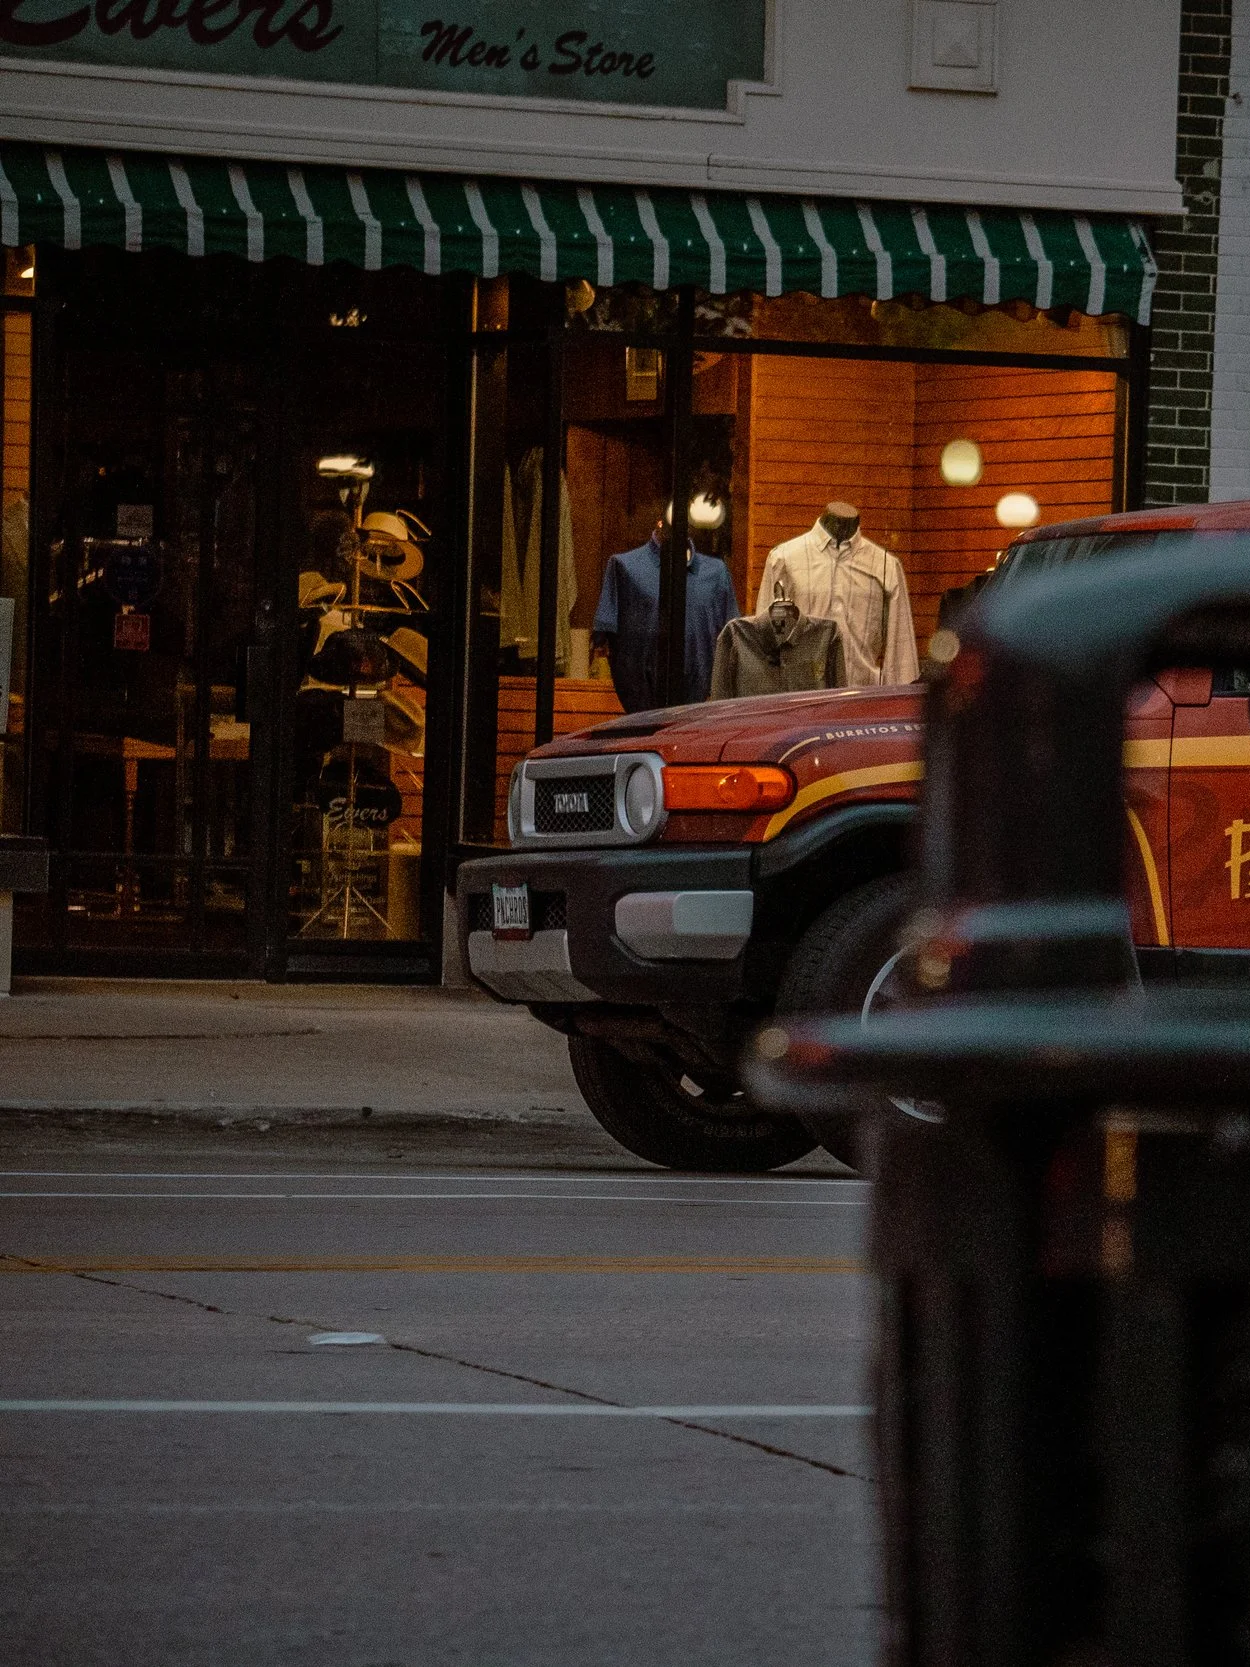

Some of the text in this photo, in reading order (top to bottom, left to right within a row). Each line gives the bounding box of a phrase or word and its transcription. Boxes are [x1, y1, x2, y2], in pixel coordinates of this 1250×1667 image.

[421, 20, 656, 78] Men's Store
[825, 725, 898, 740] BURRITOS
[554, 793, 589, 813] TOYOTA
